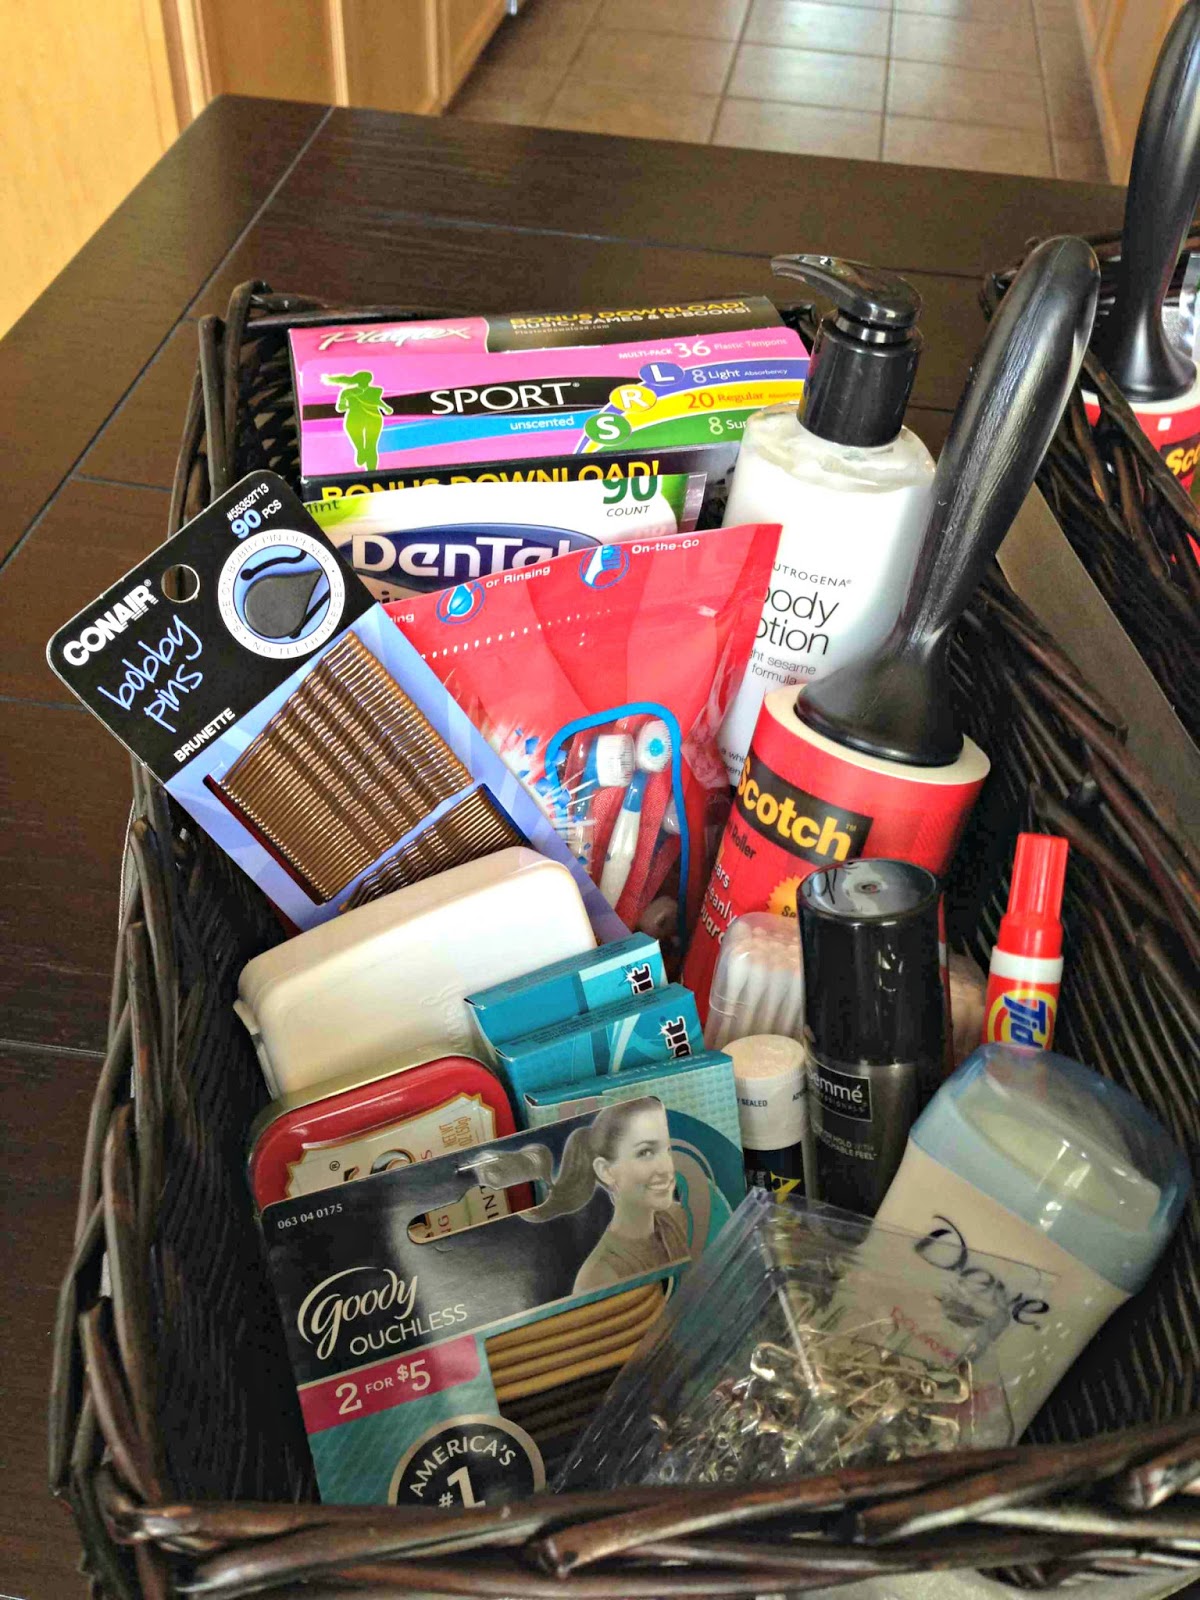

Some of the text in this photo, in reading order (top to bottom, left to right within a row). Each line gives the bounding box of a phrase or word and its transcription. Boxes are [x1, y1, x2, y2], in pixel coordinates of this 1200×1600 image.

[510, 301, 746, 325] BONUS DOWNLOAD!
[579, 313, 643, 325] GAMES
[665, 306, 751, 319] E-BOOKS!
[318, 326, 470, 351] Playtex
[618, 338, 788, 360] MULTI-PACK 36 Plastic Tampons
[652, 363, 676, 384] L
[691, 368, 707, 384] 8
[708, 368, 741, 381] Light
[430, 382, 571, 415] SPORT
[618, 388, 648, 409] R
[684, 392, 715, 409] 20
[717, 392, 765, 404] Regular
[510, 416, 575, 431] unscented
[596, 419, 622, 440] S
[708, 416, 724, 435] 8
[602, 474, 658, 504] 90
[231, 499, 282, 539] 90 PCS
[606, 504, 650, 517] COUNT
[631, 538, 700, 555] On-the-Go
[485, 566, 551, 588] or Rinsing
[63, 585, 159, 666] CONAIR
[97, 614, 203, 711] bobby
[751, 664, 797, 685] formula
[767, 655, 817, 675] sesame
[143, 663, 204, 733] pins
[173, 707, 236, 763] BRUNETTE
[737, 755, 852, 861] Scotch
[731, 826, 757, 859] Roller
[741, 1099, 768, 1108] SEALED
[277, 1203, 343, 1230] 063 04 0175
[349, 1303, 468, 1356] OUCHLESS
[335, 1359, 431, 1415] 2 FOR $5
[409, 1435, 516, 1497] AMERICA'S
